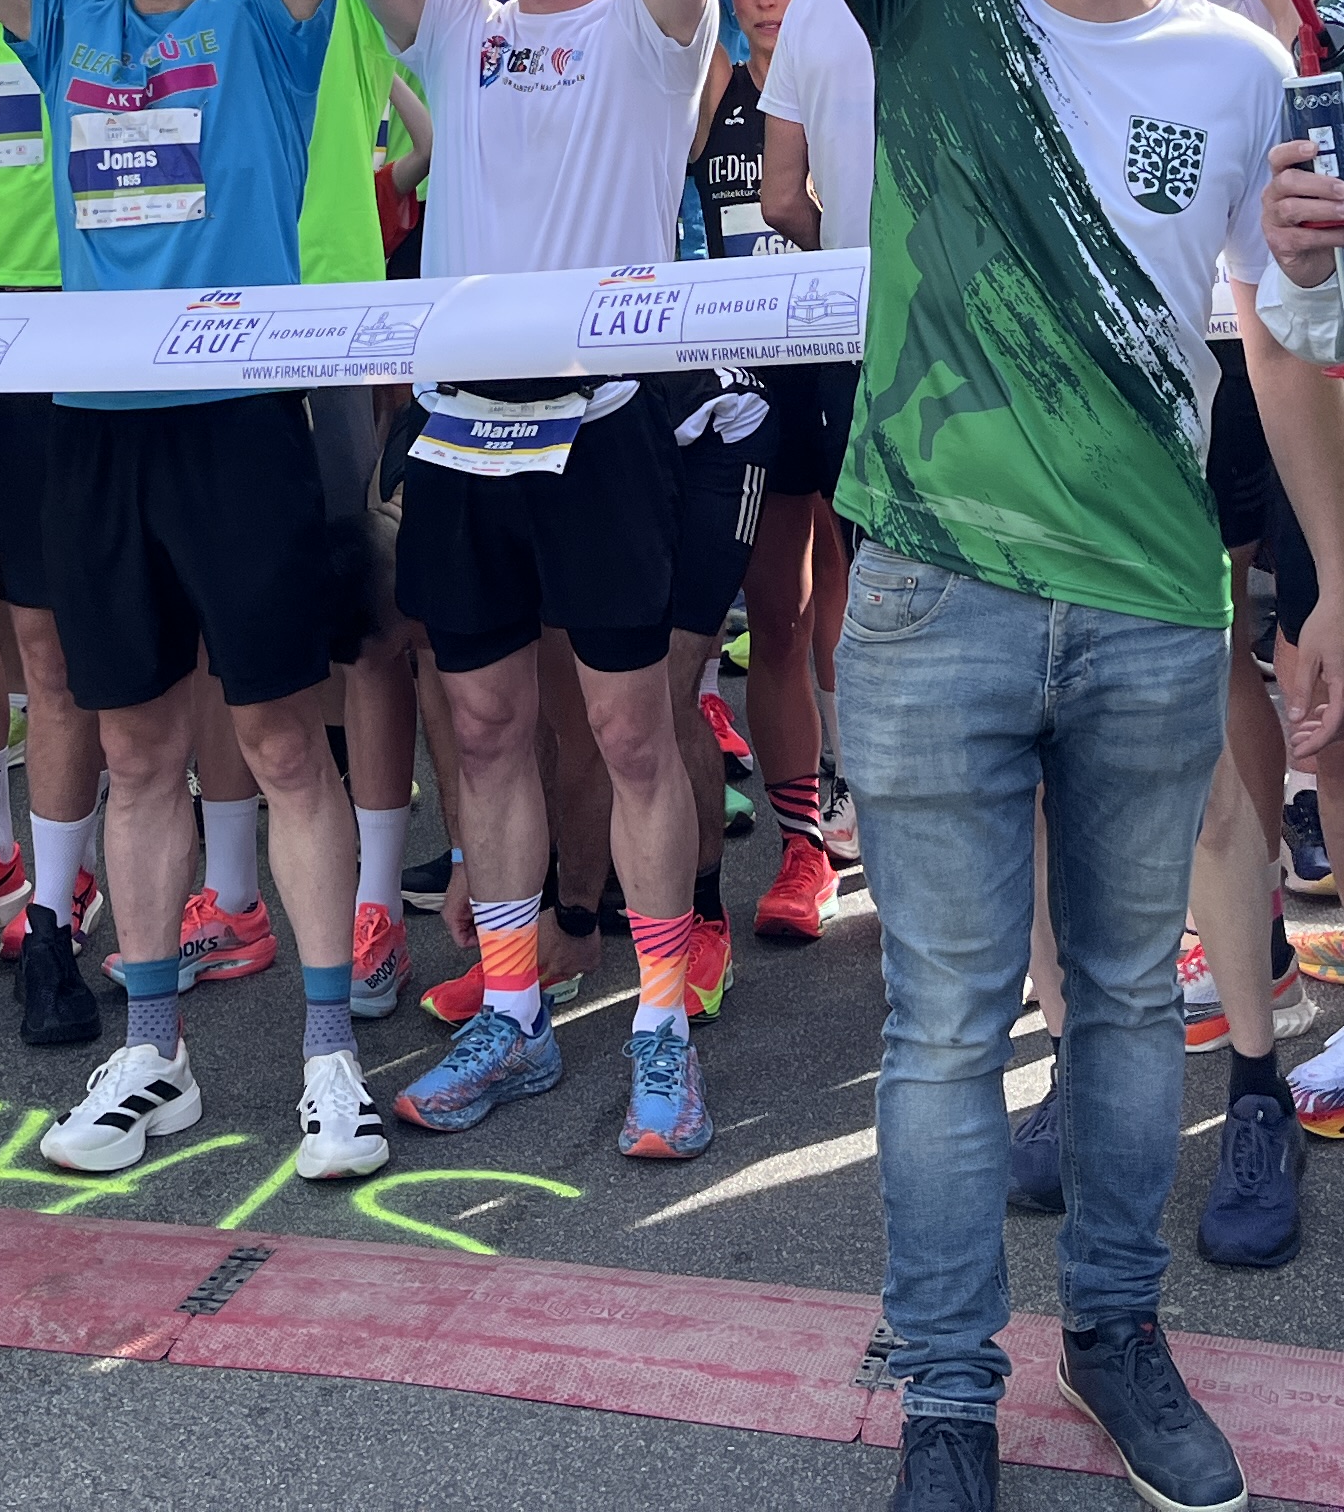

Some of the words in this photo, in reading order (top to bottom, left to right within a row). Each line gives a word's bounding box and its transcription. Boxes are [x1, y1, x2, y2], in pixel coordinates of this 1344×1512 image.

[97, 149, 158, 171] Jonas
[611, 265, 656, 278] dm
[199, 289, 243, 303] dm
[597, 289, 681, 309] FIRMEN
[695, 297, 779, 315] HOMBURG
[180, 317, 261, 332] FIRMEN
[590, 307, 675, 337] LAUF
[268, 326, 349, 340] HOMBURG
[167, 332, 251, 355] LAUF
[676, 341, 862, 364] WWW.FIRMENLAUF-HOMBURG.DE
[242, 360, 415, 380] WWW.FIRMENLAUF-HOMBURG.DE
[470, 421, 539, 439] Martin
[179, 936, 219, 961] OKS
[1185, 1376, 1249, 1395] RESU
